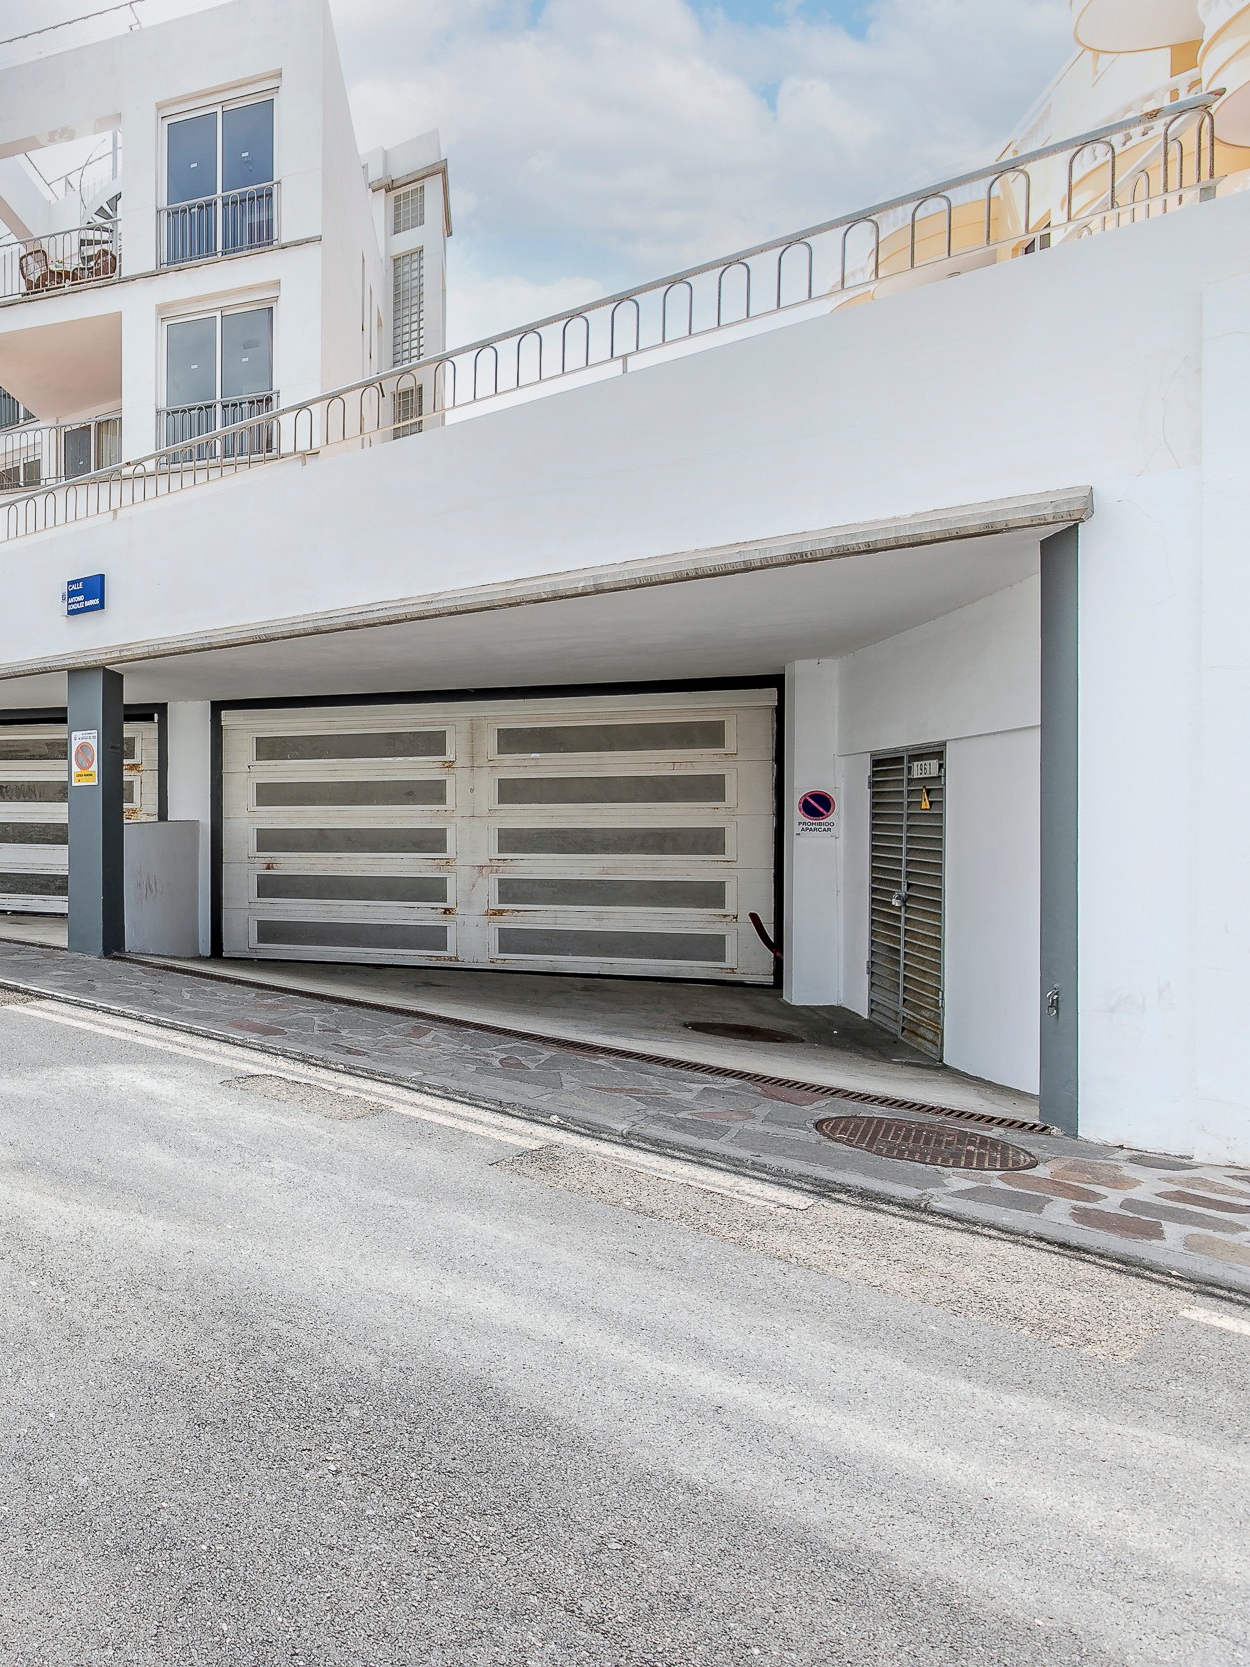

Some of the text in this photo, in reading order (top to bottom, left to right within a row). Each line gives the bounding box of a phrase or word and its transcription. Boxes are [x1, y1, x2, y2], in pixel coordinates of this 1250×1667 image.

[68, 582, 83, 591] CALLE
[68, 595, 84, 603] ANTONIO
[916, 762, 932, 776] 1961
